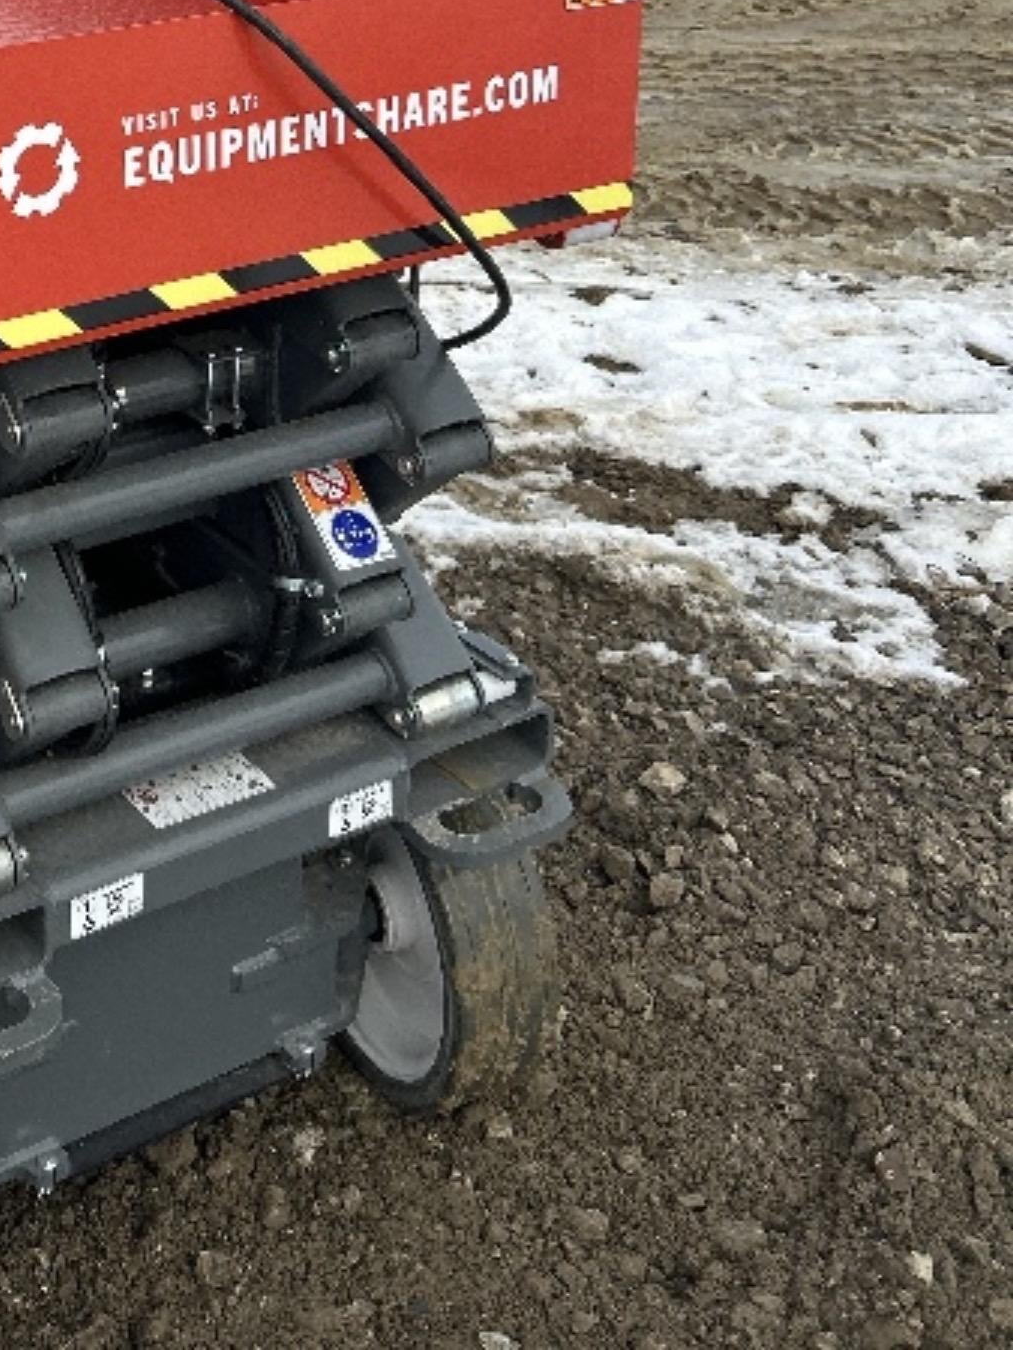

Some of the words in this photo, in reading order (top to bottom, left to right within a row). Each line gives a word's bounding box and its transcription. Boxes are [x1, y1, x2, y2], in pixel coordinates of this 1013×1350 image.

[121, 106, 180, 136] VISIT
[190, 100, 218, 122] US
[227, 92, 260, 115] AT:
